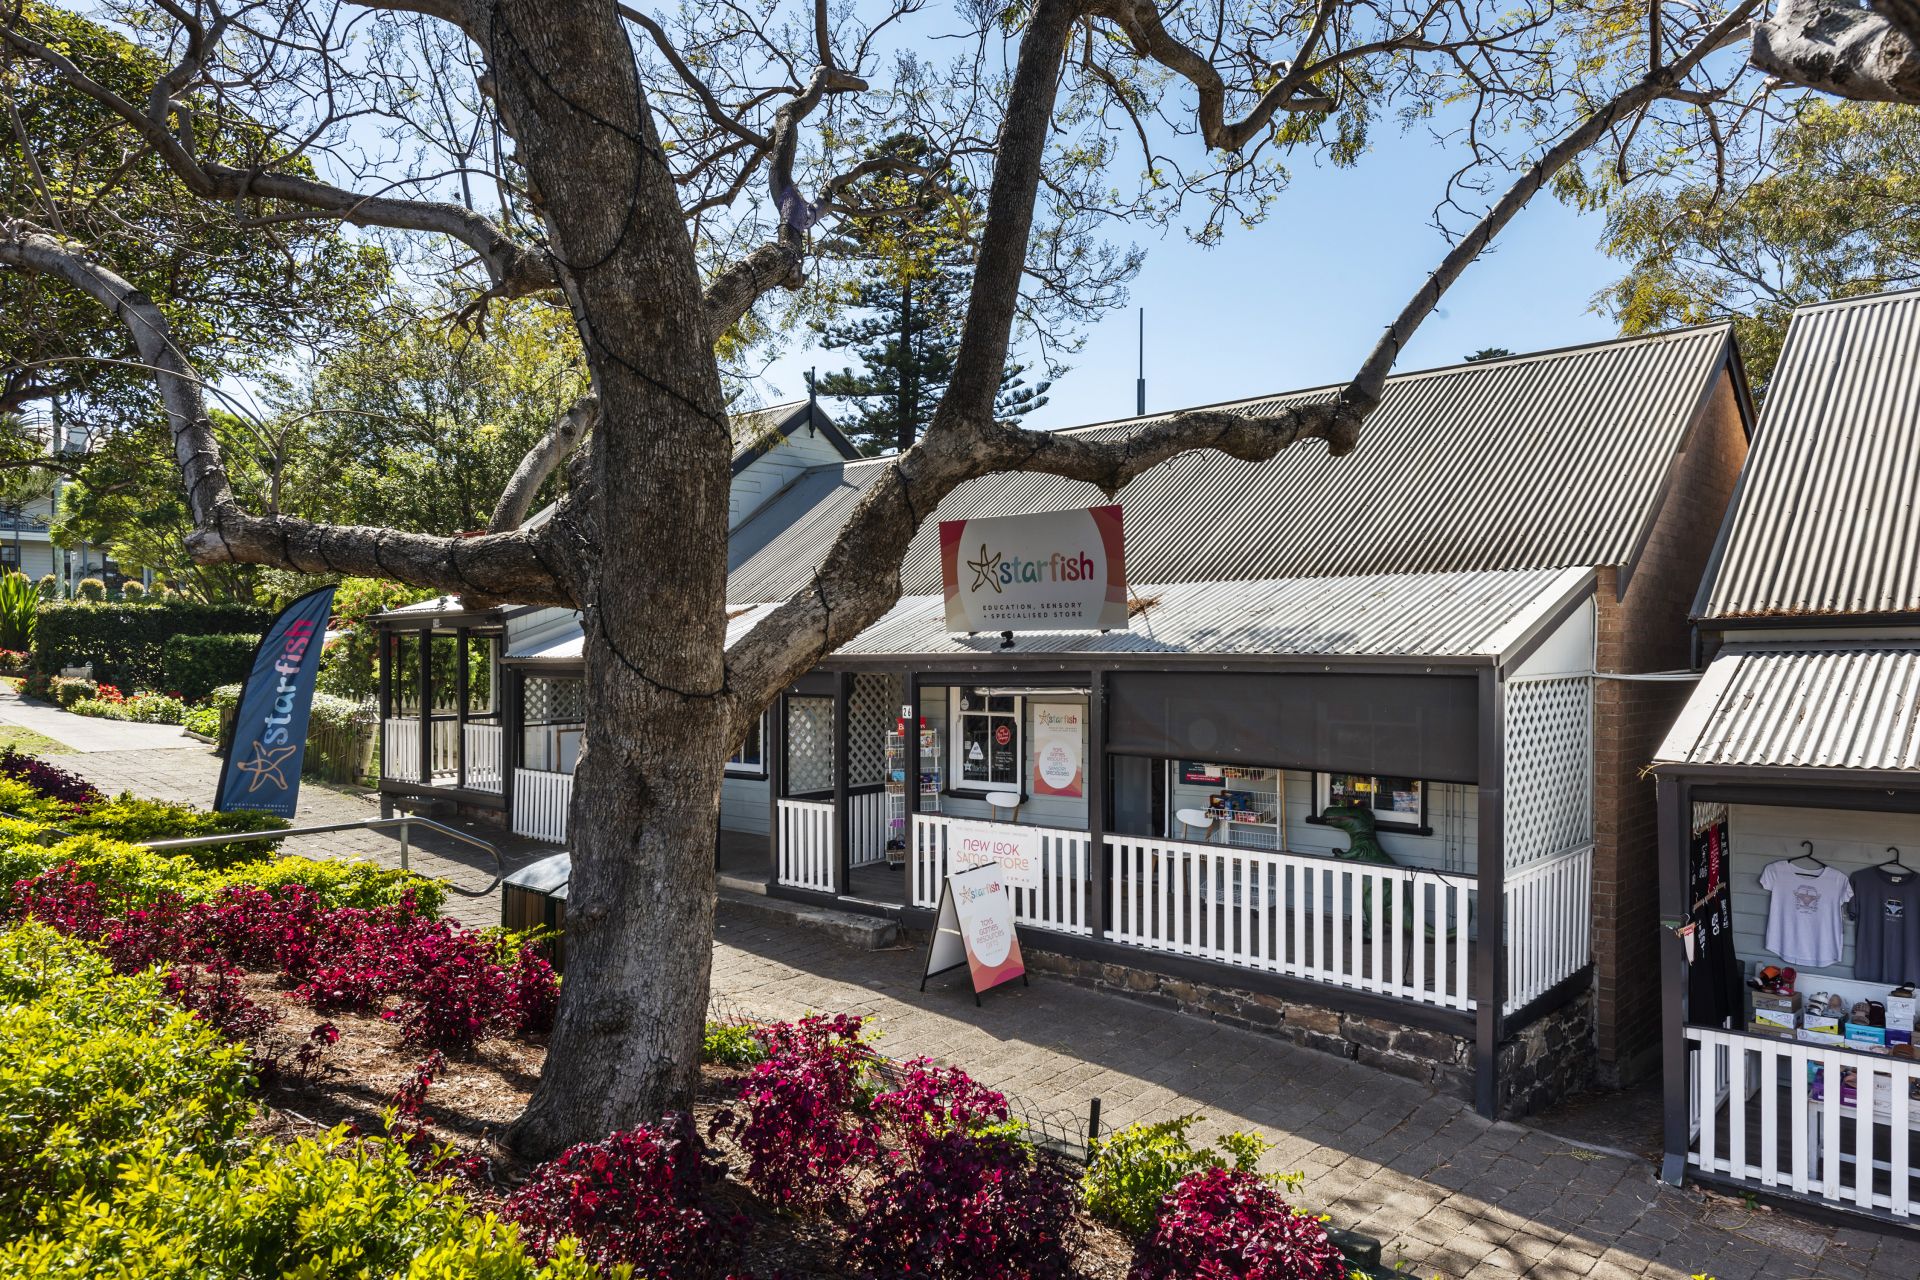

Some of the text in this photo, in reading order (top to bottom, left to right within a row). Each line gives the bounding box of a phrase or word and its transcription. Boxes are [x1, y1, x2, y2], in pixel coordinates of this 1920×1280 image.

[1000, 551, 1094, 584] starfish
[264, 618, 314, 746] starfish
[903, 707, 911, 717] 26
[1048, 714, 1077, 725] starfish
[970, 881, 1001, 900] starfish
